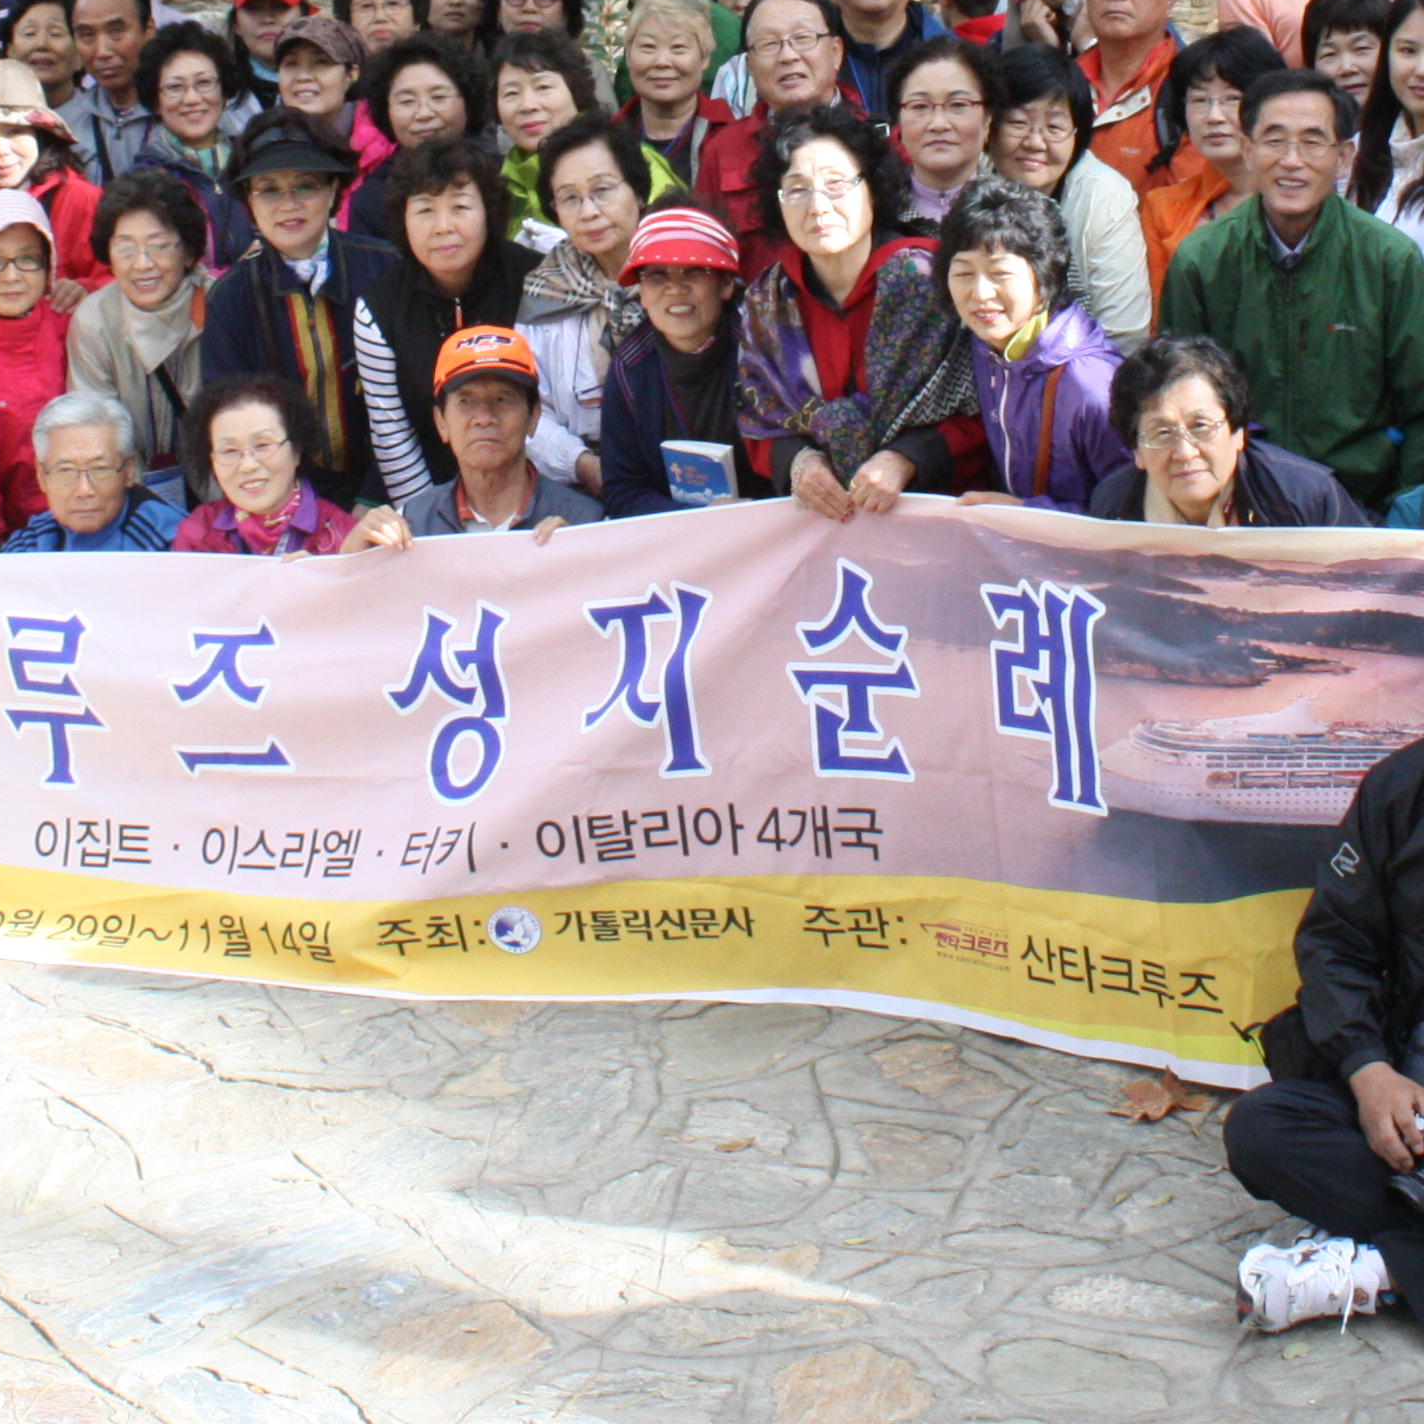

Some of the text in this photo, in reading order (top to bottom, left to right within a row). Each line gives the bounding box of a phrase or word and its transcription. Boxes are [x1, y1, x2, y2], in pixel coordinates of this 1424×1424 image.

[34, 802, 883, 878] 이집트 이스라엘 터키 이탈리아 4개국
[259, 920, 337, 963] 14일
[553, 906, 756, 944] 가톨릭신문사
[1019, 933, 1225, 1015] 산타크루즈
